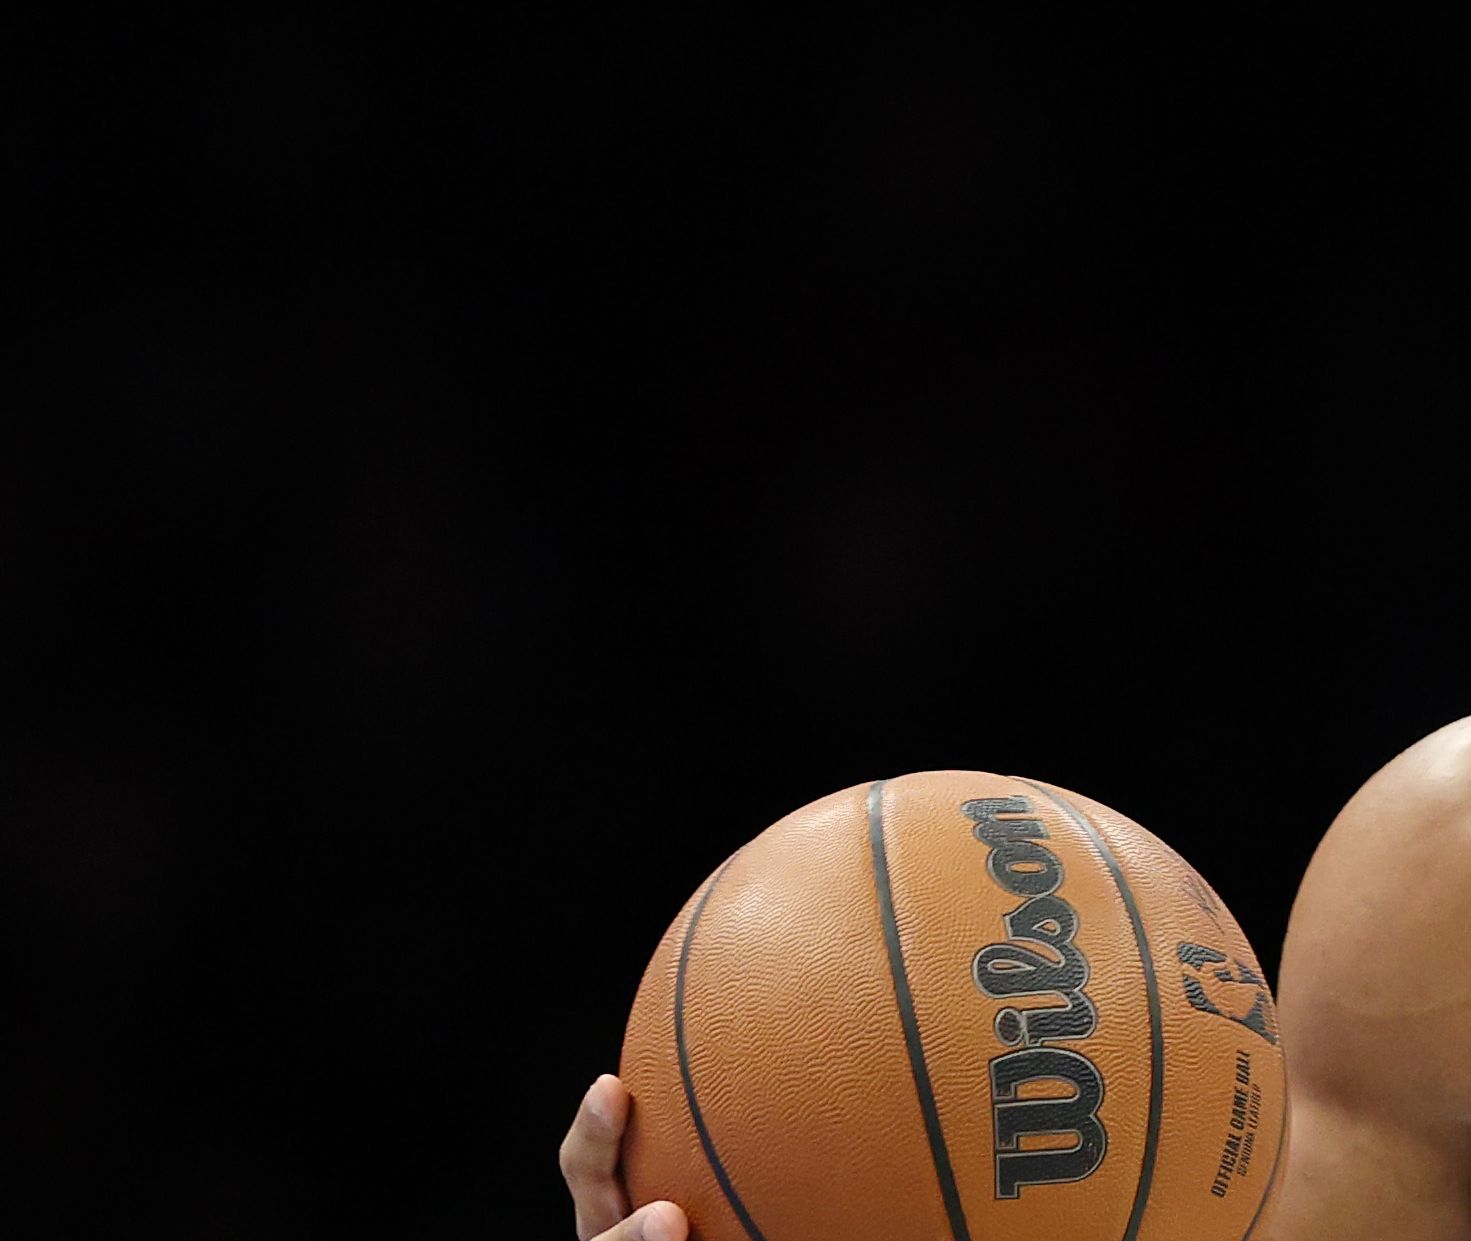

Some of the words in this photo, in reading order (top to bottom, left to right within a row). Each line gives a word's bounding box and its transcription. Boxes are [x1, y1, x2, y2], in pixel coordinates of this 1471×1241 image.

[961, 795, 1109, 1200] Wilson
[1236, 1049, 1251, 1086] BALL
[1230, 1085, 1249, 1131] GAME
[1211, 1133, 1243, 1199] OFFICIAL
